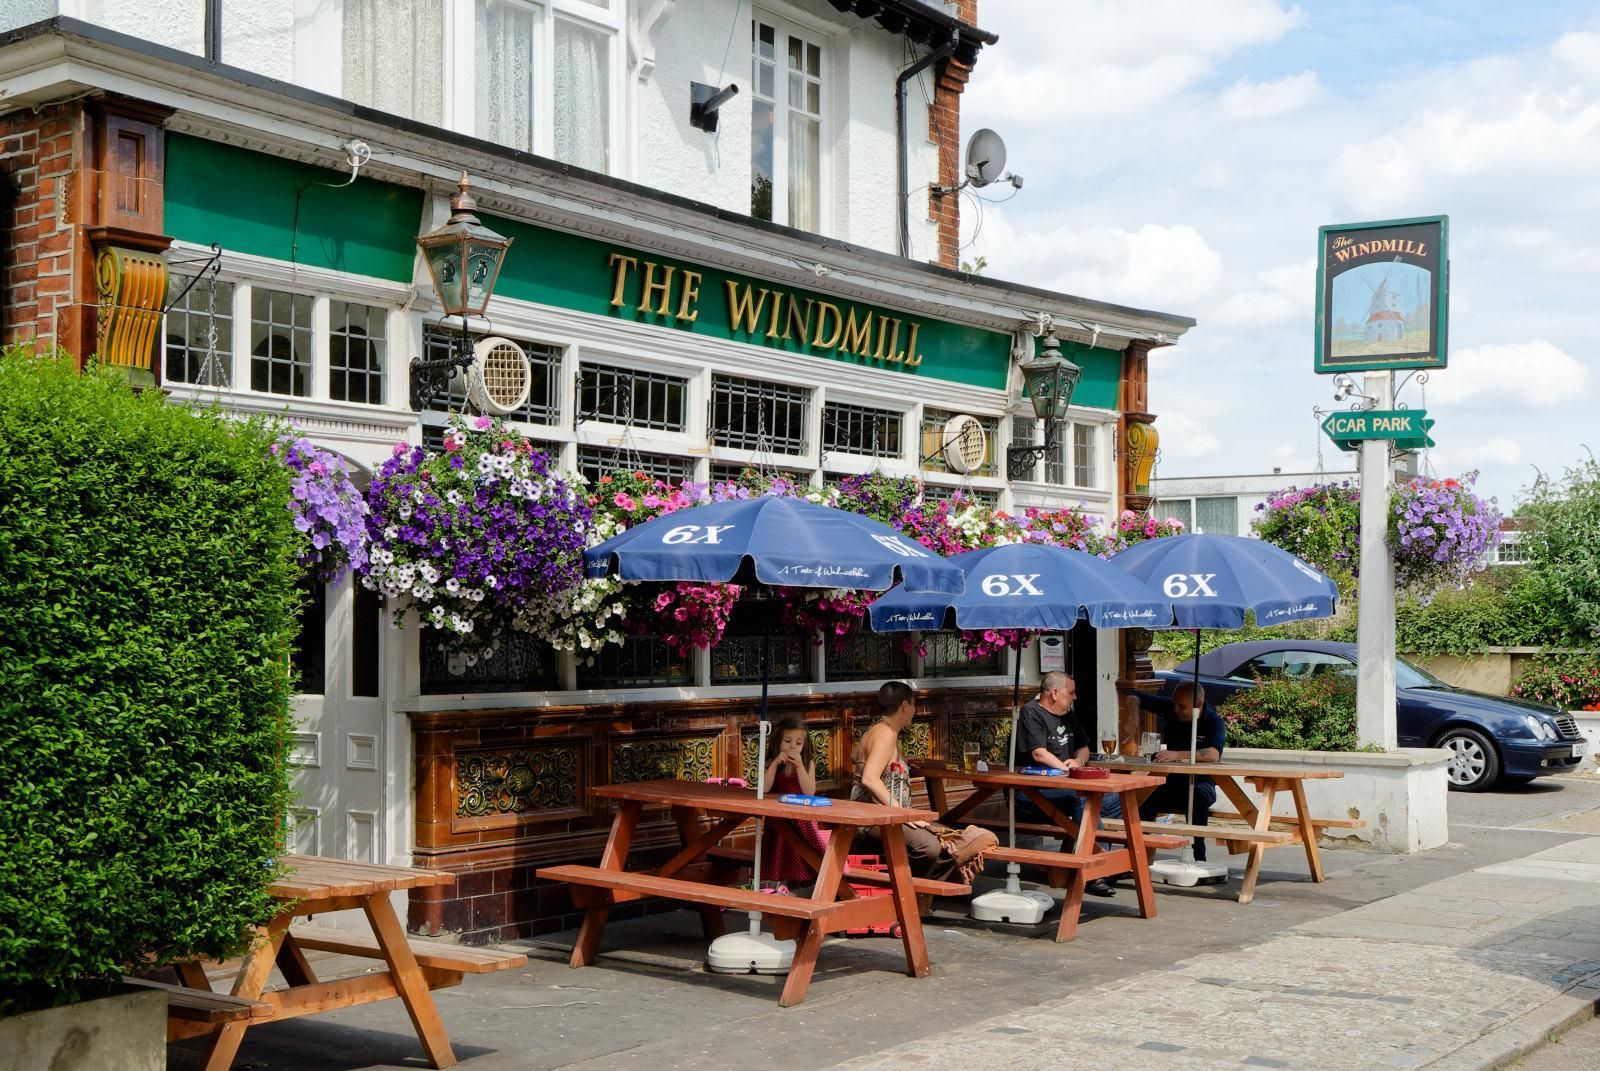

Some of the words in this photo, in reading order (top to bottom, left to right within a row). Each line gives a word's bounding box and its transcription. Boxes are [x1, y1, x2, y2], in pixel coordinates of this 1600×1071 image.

[1332, 236, 1354, 249] The
[1335, 239, 1427, 262] WINDMILL
[608, 253, 702, 322] THE
[726, 279, 923, 367] WINDMILL
[1336, 418, 1366, 432] CAR
[1373, 417, 1412, 432] PARK
[662, 525, 736, 544] 6X
[981, 574, 1044, 597] 6X
[1163, 573, 1218, 598] 6X
